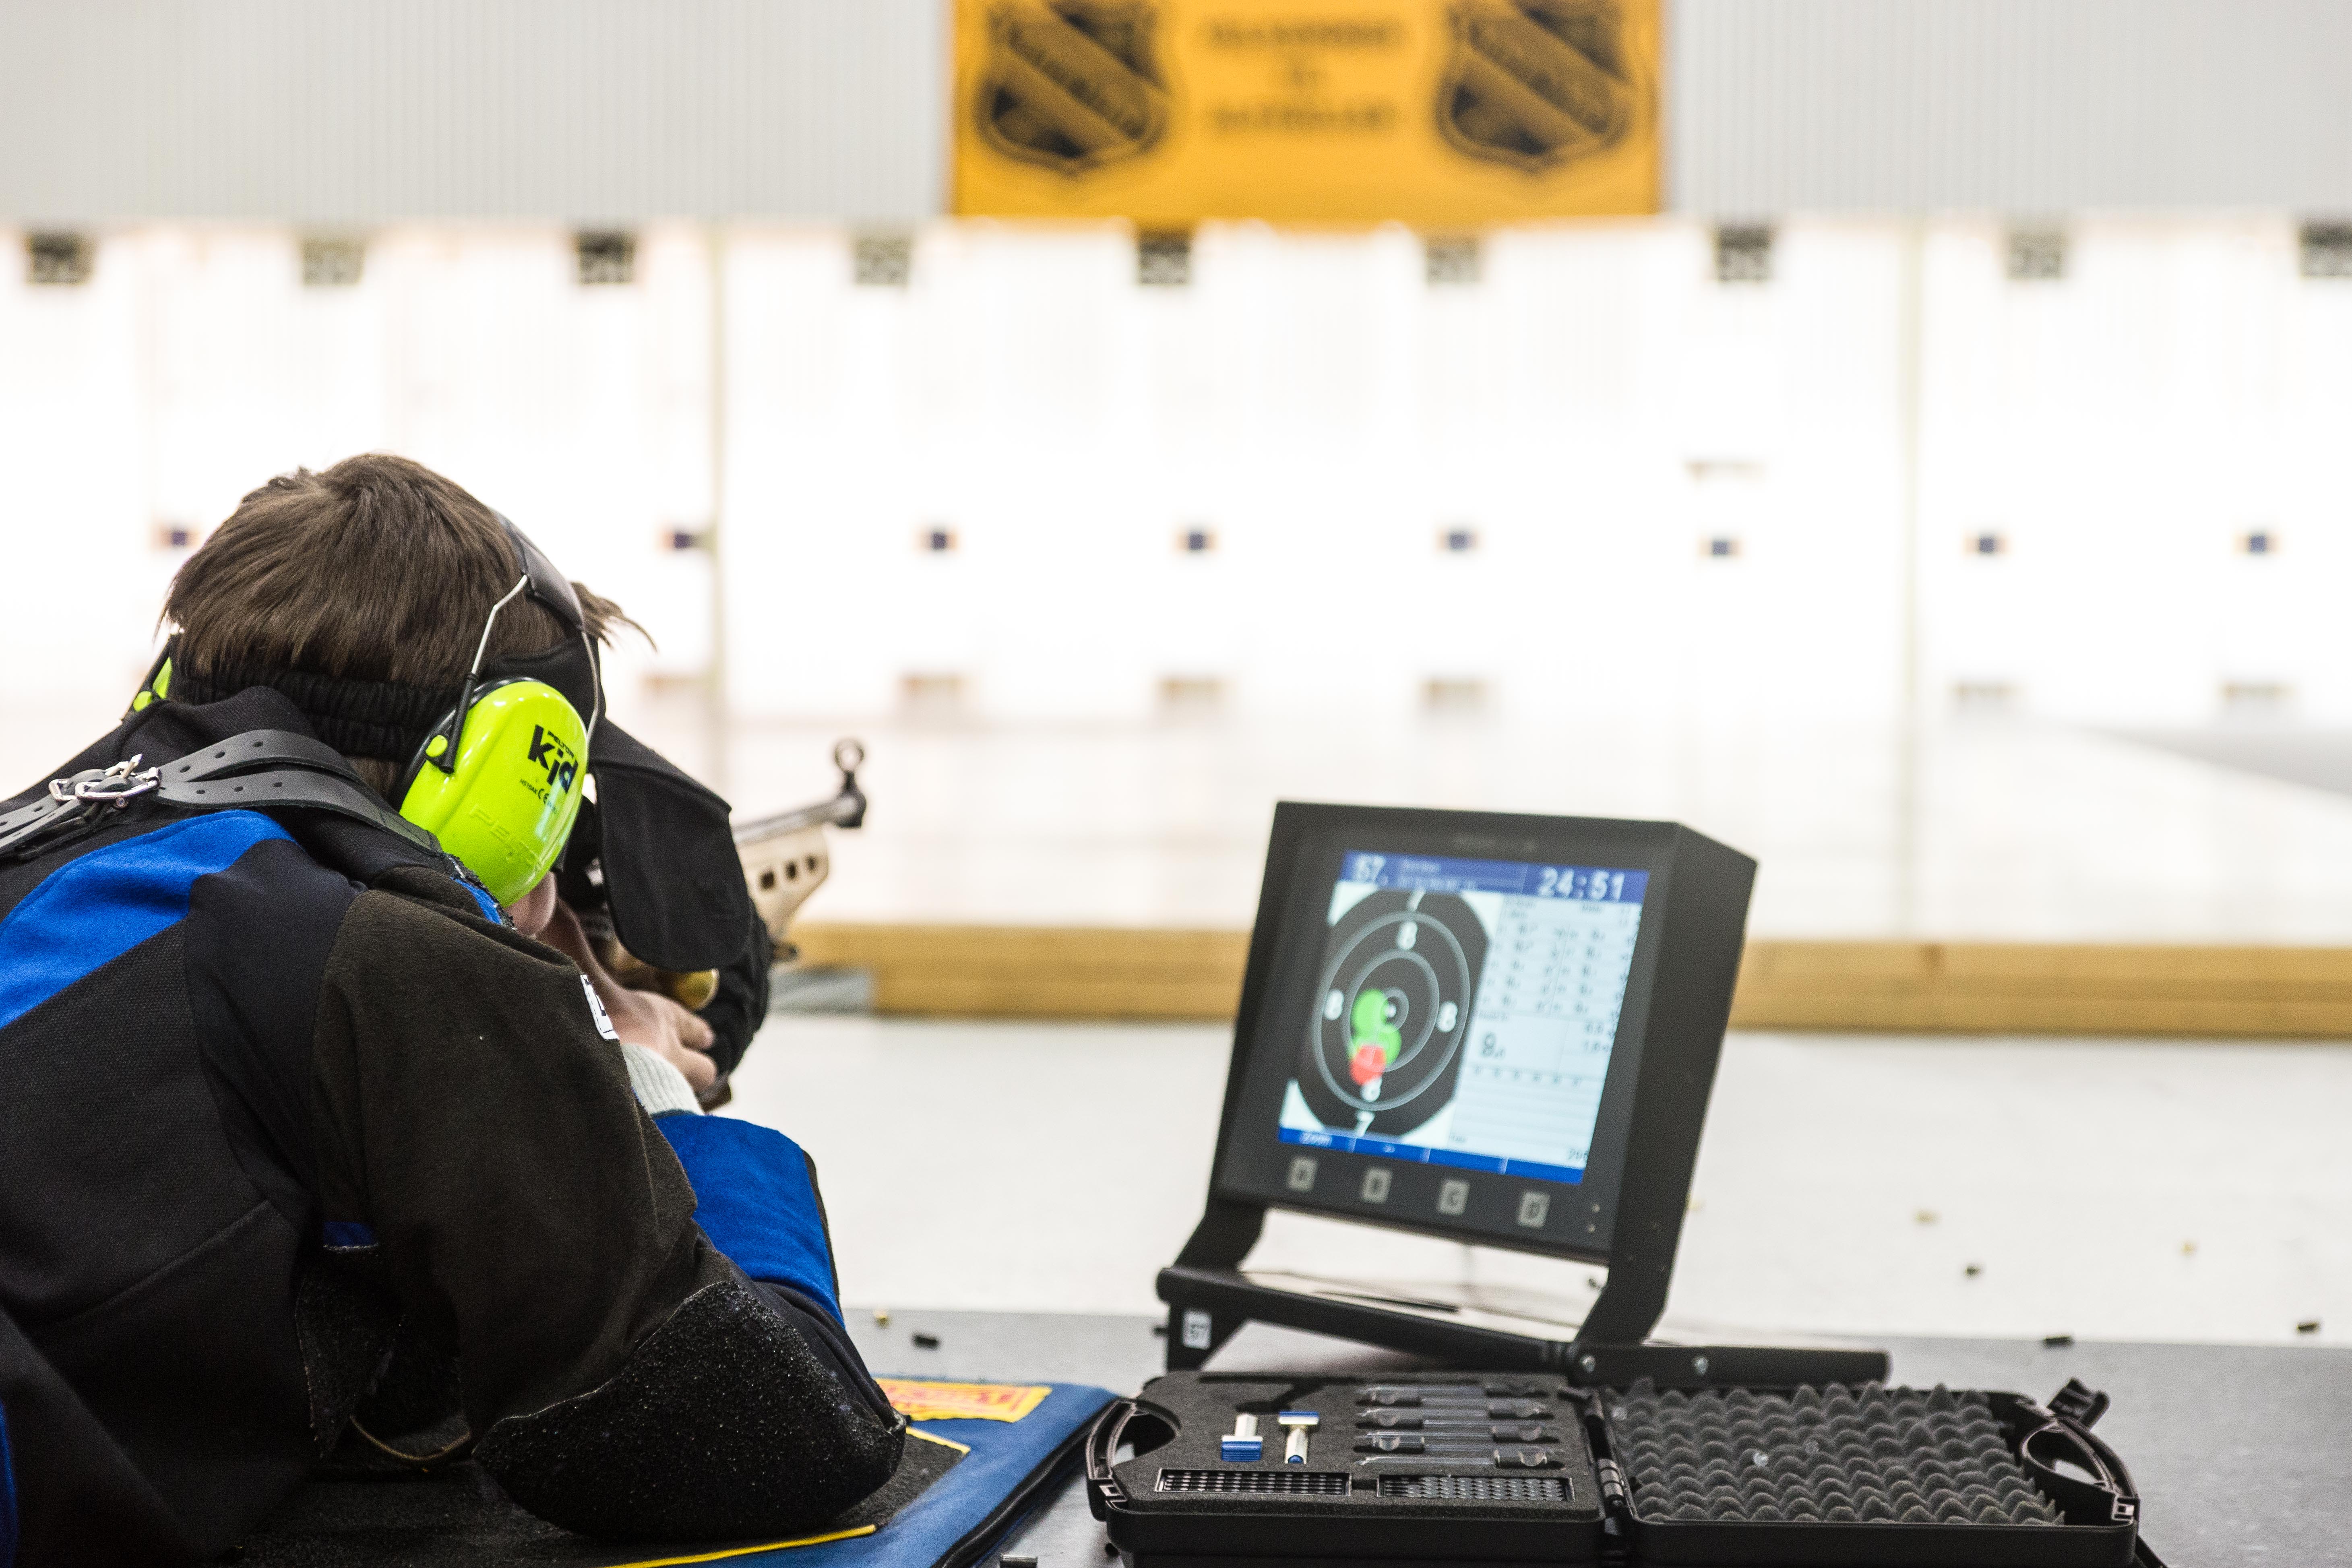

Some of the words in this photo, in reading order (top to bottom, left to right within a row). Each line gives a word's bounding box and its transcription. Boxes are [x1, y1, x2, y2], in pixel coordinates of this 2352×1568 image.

[528, 724, 579, 794] kid
[547, 731, 574, 758] PELTOR
[1537, 866, 1625, 901] 24:51
[1397, 920, 1418, 950] 8
[1325, 989, 1345, 1021] 8
[1437, 1001, 1458, 1033] 8
[1356, 1110, 1376, 1137] 7
